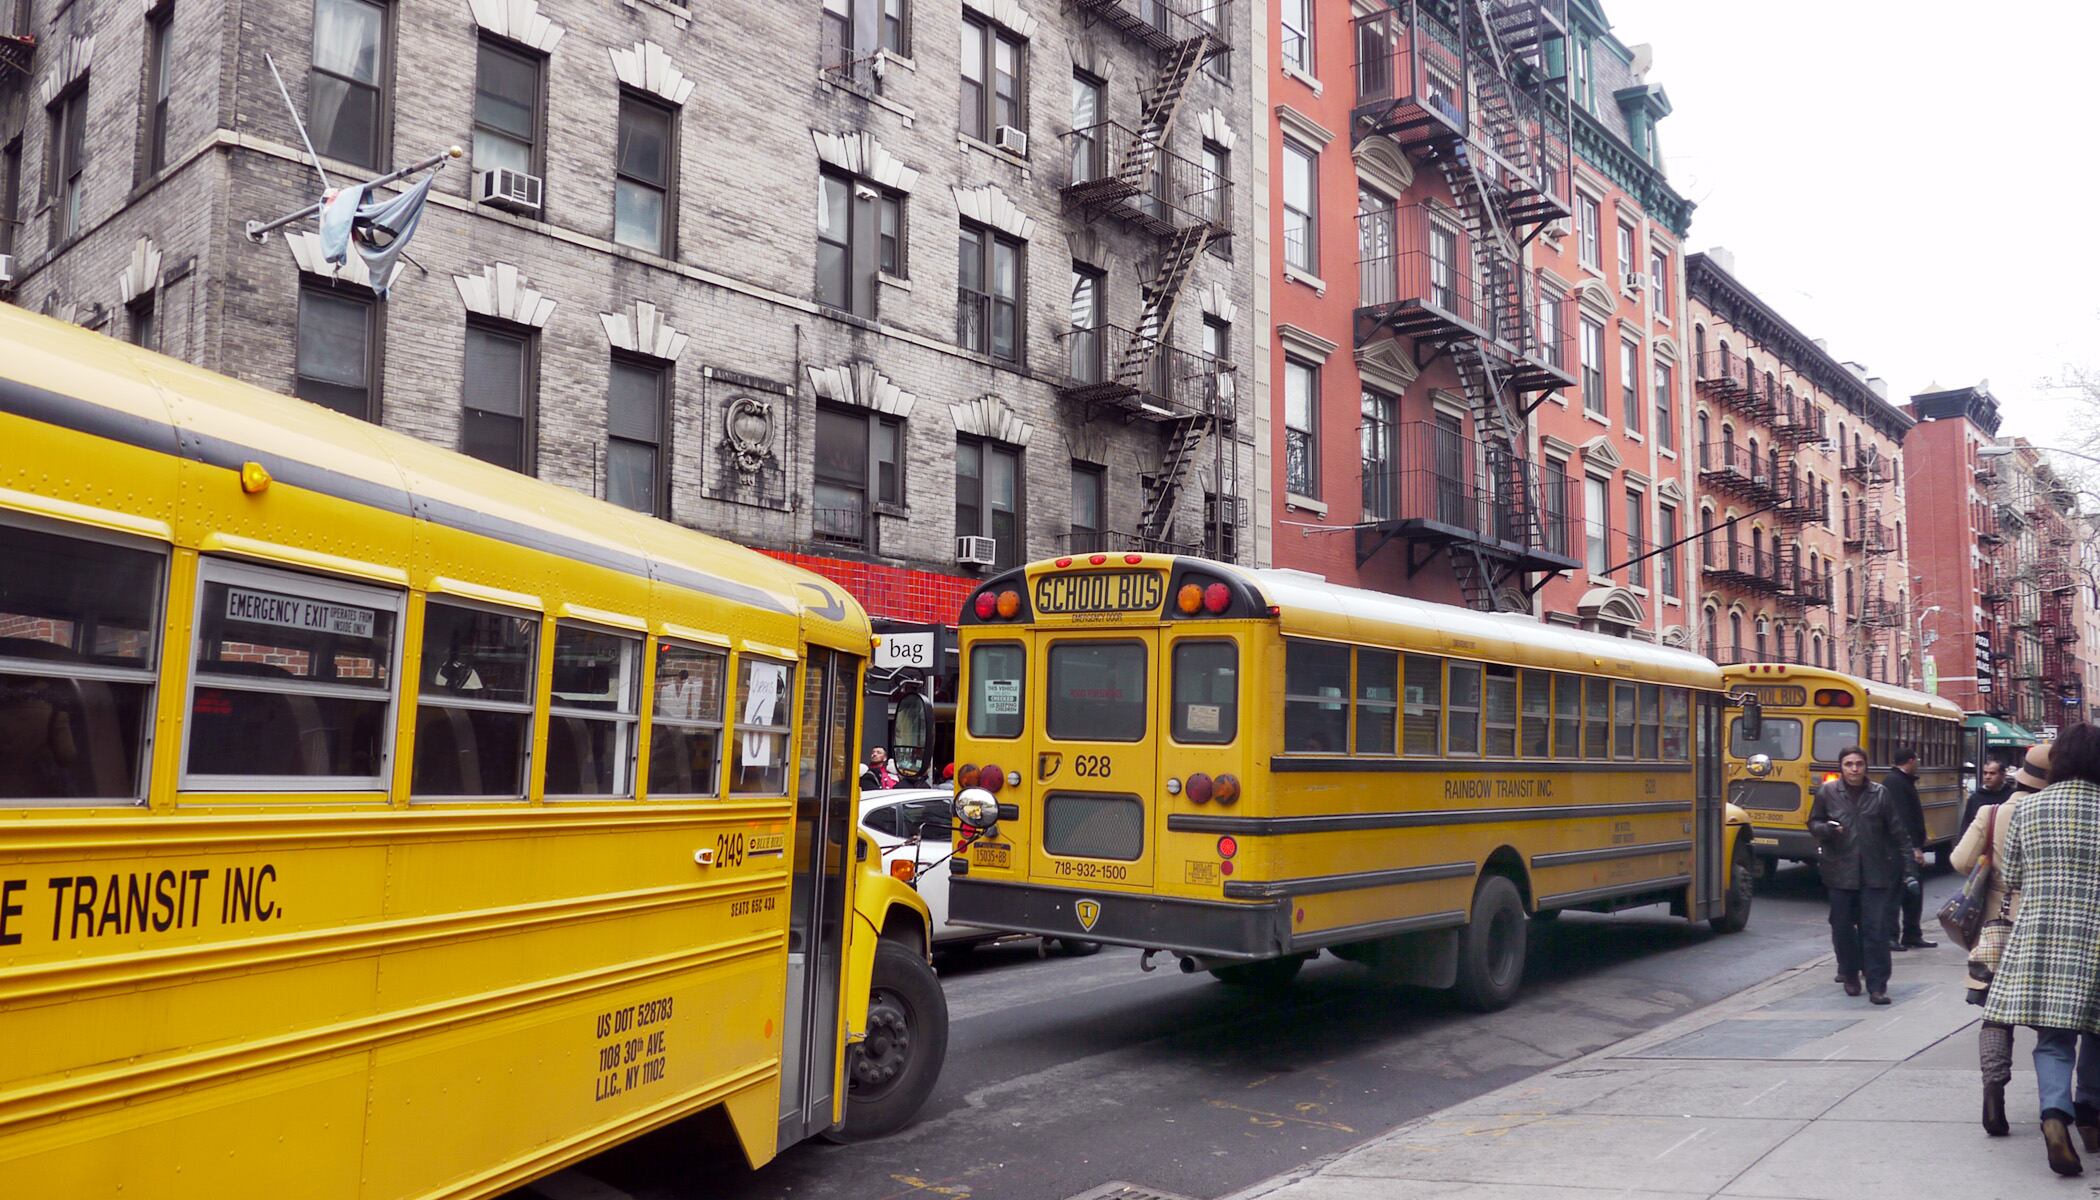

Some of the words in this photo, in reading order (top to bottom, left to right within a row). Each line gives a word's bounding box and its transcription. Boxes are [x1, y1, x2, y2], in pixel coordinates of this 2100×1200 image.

[1040, 575, 1113, 610] SCHOOL
[1119, 573, 1159, 609] BUS
[229, 592, 300, 625] EMERGENCY
[305, 604, 329, 628] EXIT
[359, 610, 373, 623] FROM
[890, 638, 923, 663] bag
[1781, 687, 1804, 706] BUS
[1075, 755, 1111, 778] 628
[1444, 779, 1492, 799] RAINBOW
[1496, 779, 1533, 798] TRANSIT
[1537, 779, 1554, 797] INC.
[716, 832, 743, 868] 2149
[1055, 861, 1127, 880] 718-932-1500
[0, 879, 27, 946] E
[48, 869, 209, 941] TRANSIT
[221, 863, 282, 924] INC.
[731, 900, 750, 918] SEATS
[596, 1012, 611, 1040] US
[614, 1006, 635, 1034] DOT
[637, 996, 673, 1027] 528783
[599, 1043, 621, 1073] 1108
[623, 1037, 644, 1064] 30th
[646, 1030, 666, 1057] AVE.
[625, 1065, 640, 1091] NY
[642, 1056, 666, 1085] 11102
